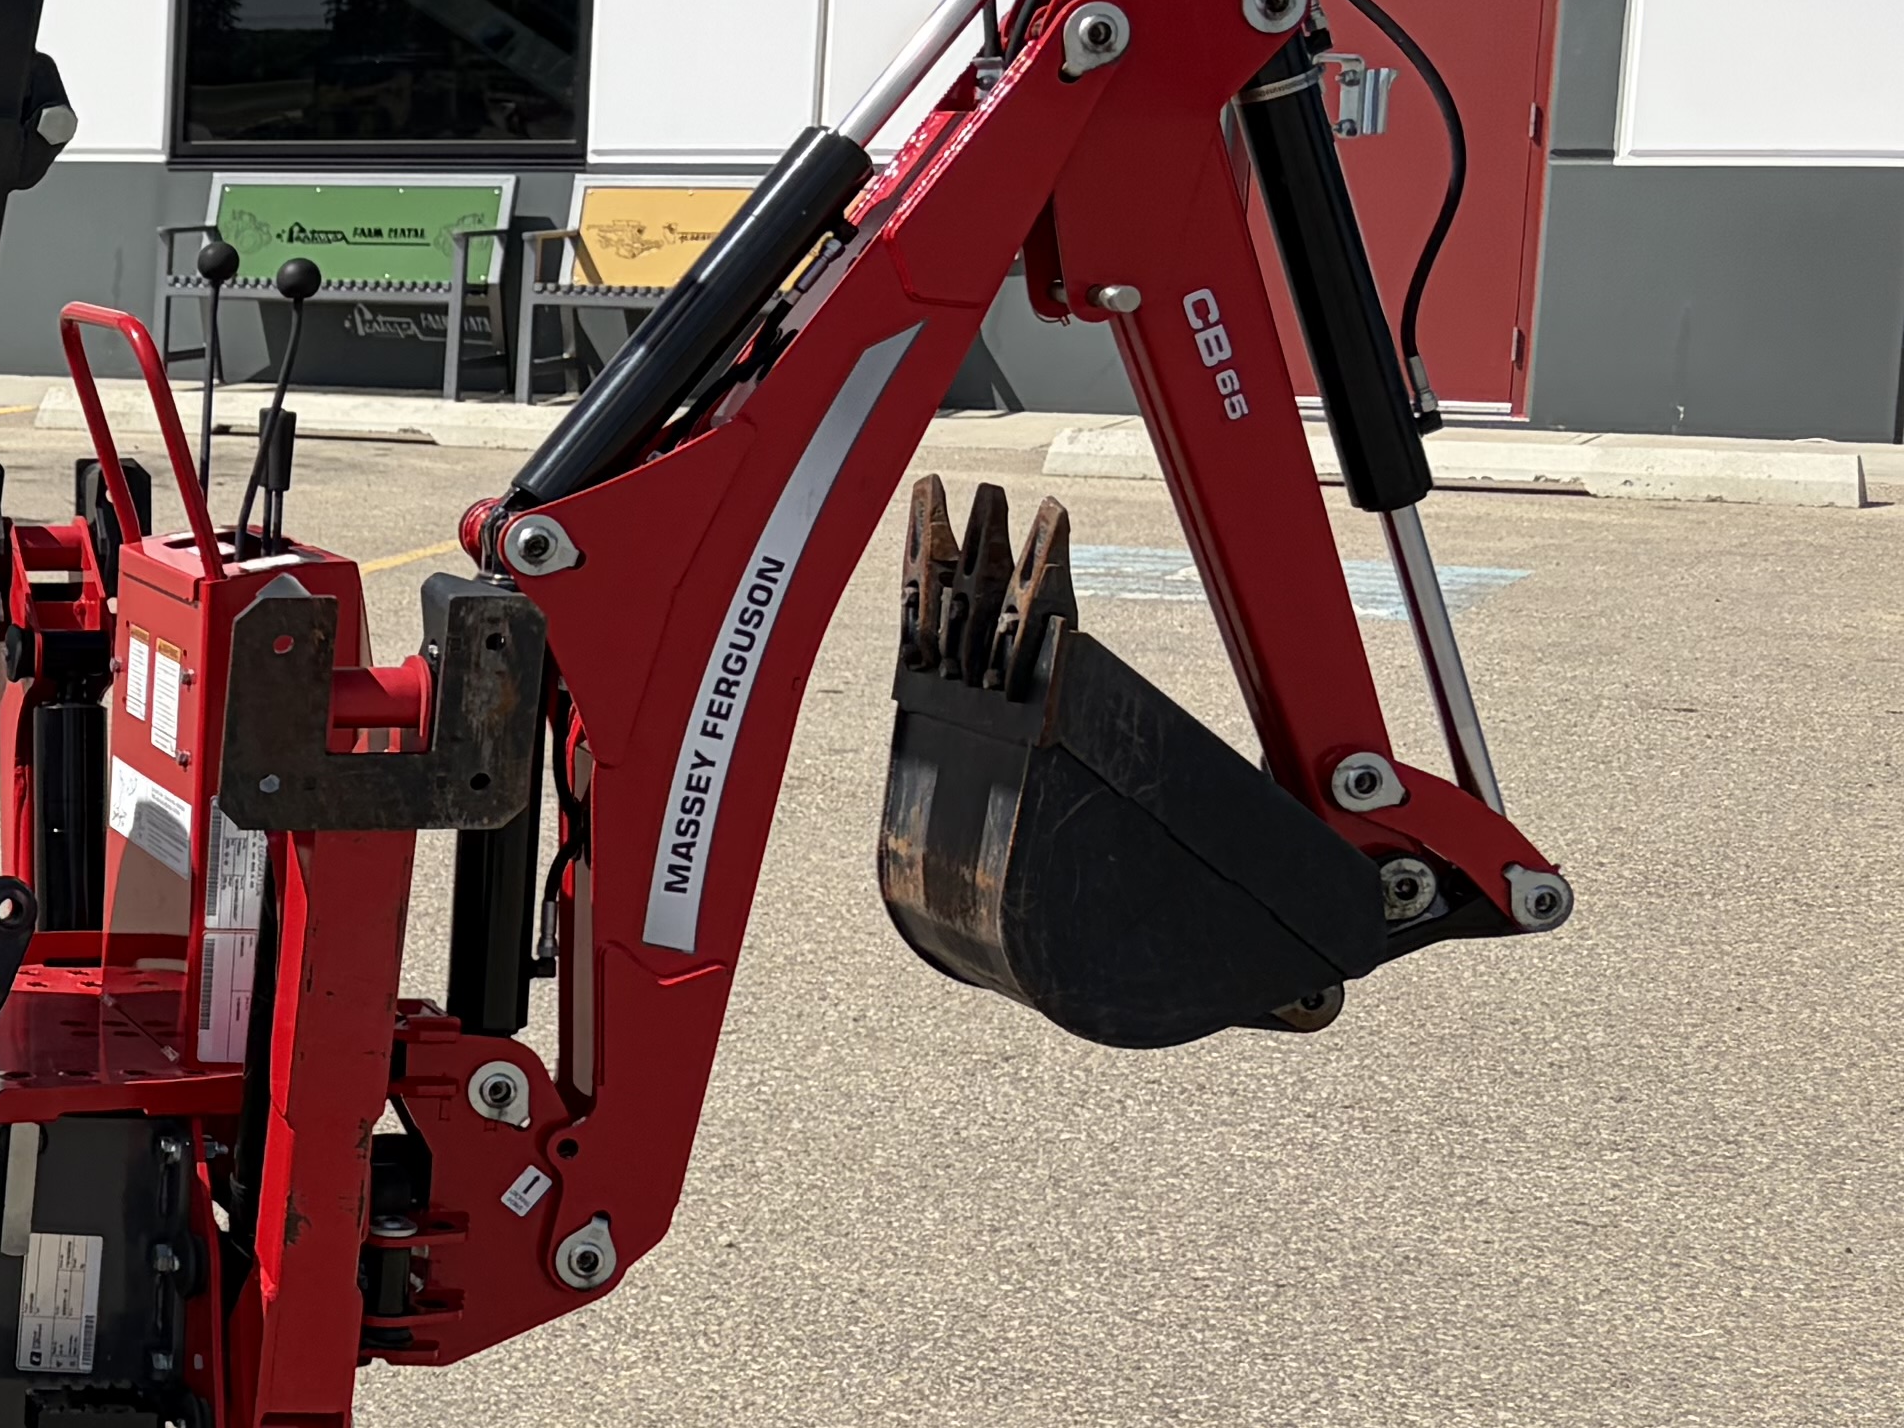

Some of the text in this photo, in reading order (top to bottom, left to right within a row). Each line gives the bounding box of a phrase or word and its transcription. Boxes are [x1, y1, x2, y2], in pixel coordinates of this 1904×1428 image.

[1183, 288, 1249, 421] CB 65
[663, 556, 786, 896] MASSEY FERGUSON
